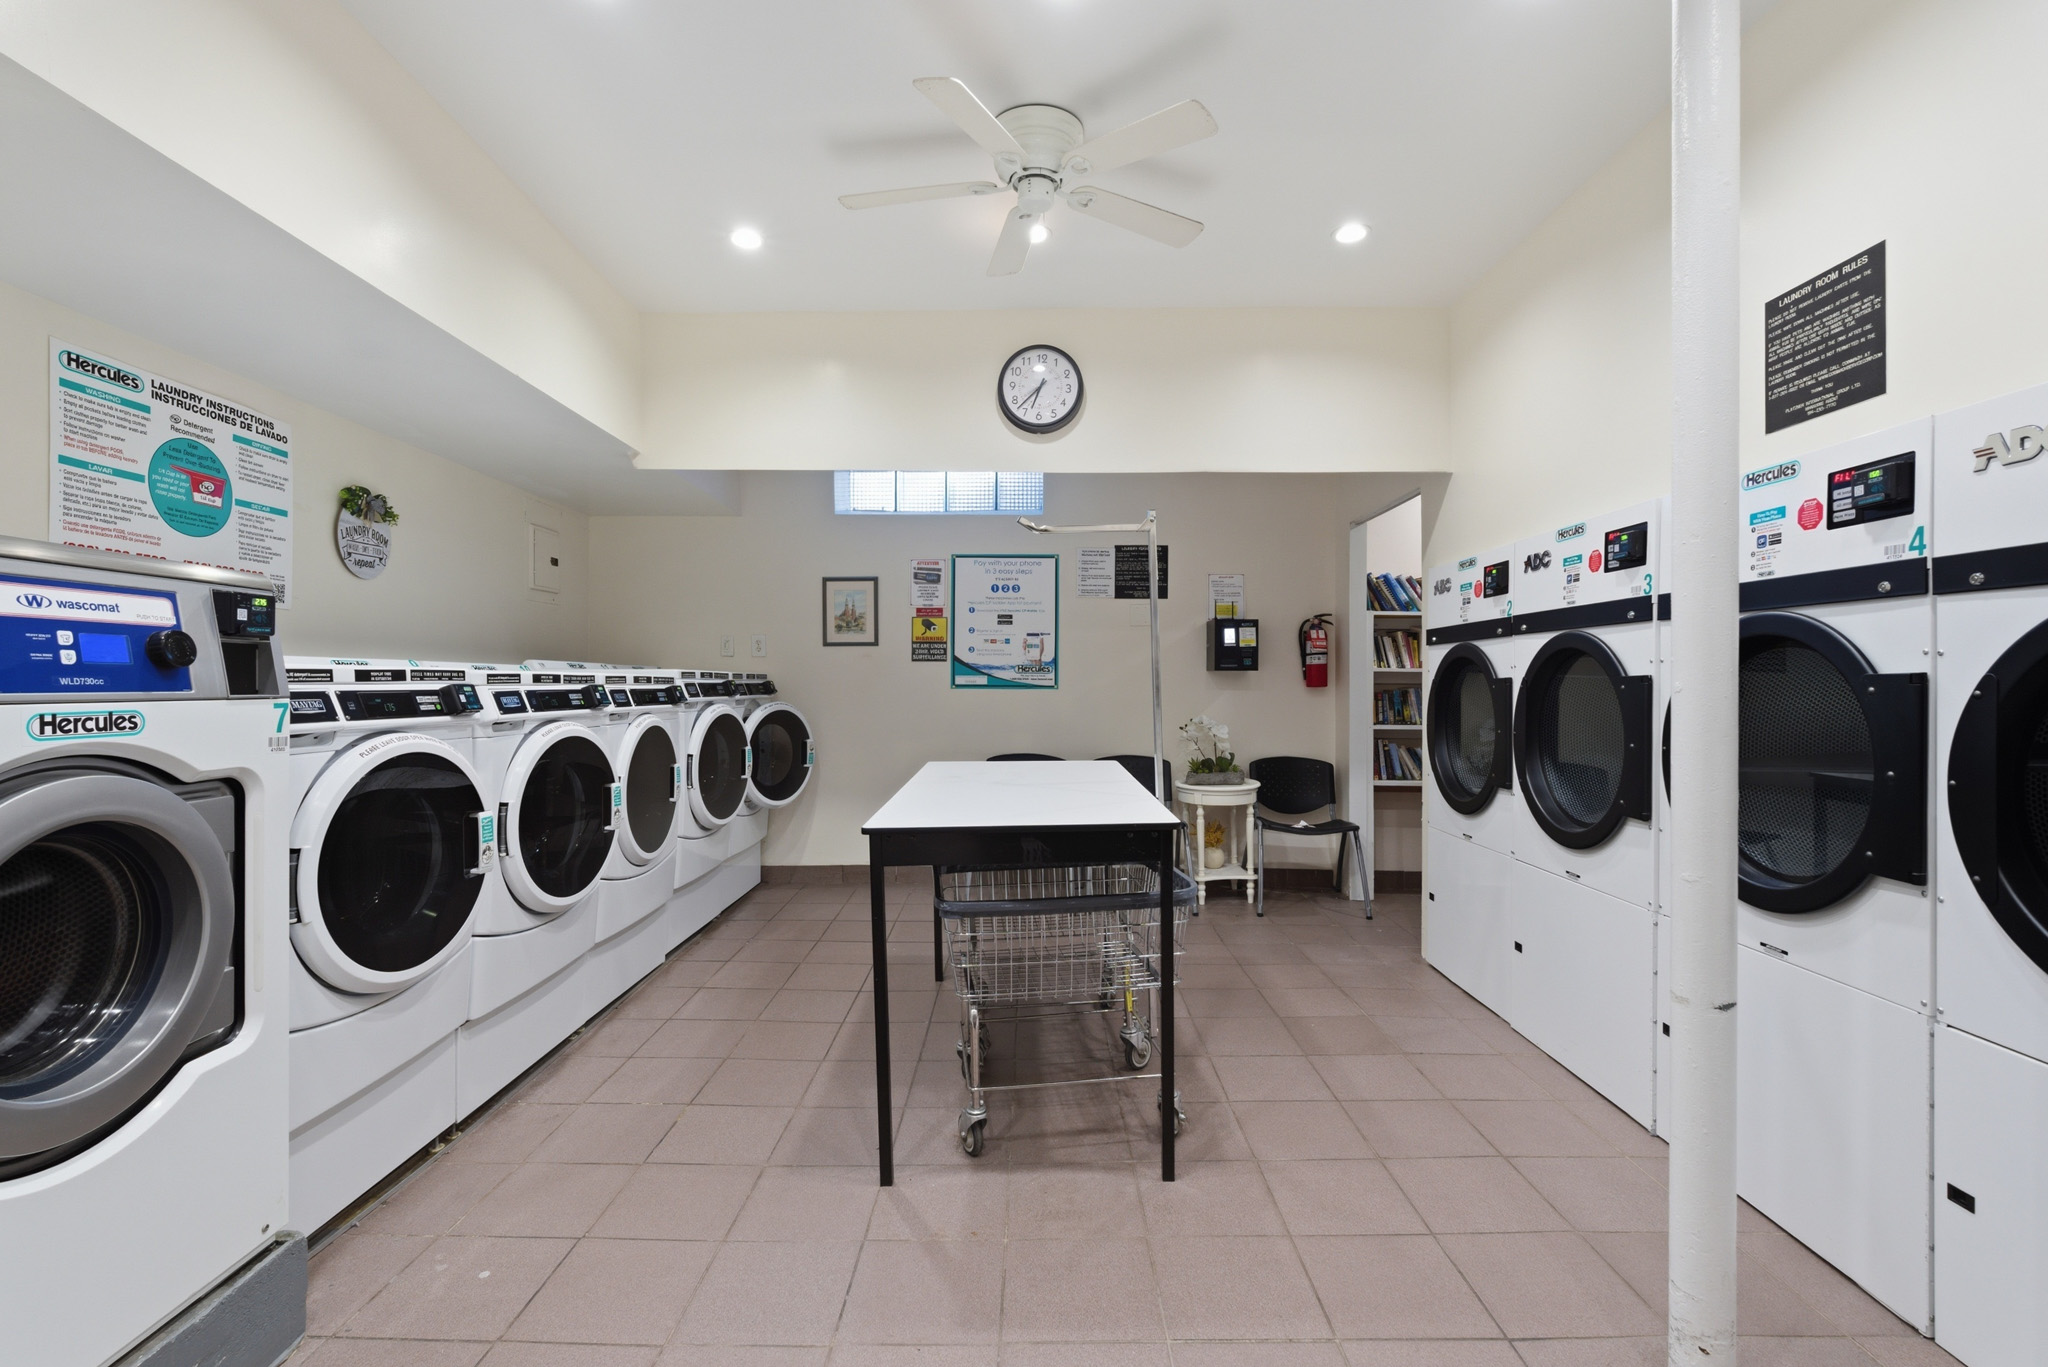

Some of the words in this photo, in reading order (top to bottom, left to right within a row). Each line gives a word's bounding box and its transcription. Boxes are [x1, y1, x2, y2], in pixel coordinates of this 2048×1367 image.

[1779, 284, 1812, 308] LAUNDRY
[1816, 270, 1838, 289] ROOM
[1843, 254, 1868, 275] RULES
[1022, 357, 1031, 366] 11
[1037, 354, 1048, 363] 12
[66, 351, 139, 391] Hercules
[1011, 367, 1021, 376] 10
[1064, 370, 1070, 378] 2
[1010, 382, 1016, 390] 9
[1066, 384, 1071, 393] 3
[86, 387, 121, 404] WASHING
[151, 378, 202, 405] LAUNDRY
[206, 398, 274, 430] INSTRUCTIONS
[1012, 396, 1018, 404] 8
[1060, 398, 1066, 406] 4
[151, 389, 237, 427] INSTRUCCIONES
[240, 420, 252, 432] DE
[256, 426, 287, 444] LAVADO
[1023, 408, 1028, 416] 7
[1036, 411, 1042, 420] 6
[1051, 409, 1057, 418] 5
[171, 424, 215, 444] Recommended
[184, 419, 213, 436] Detergent
[1972, 424, 2048, 473] AD
[89, 464, 112, 475] LAVAR
[1746, 464, 1797, 487] Hercules
[1834, 471, 1855, 483] FIL
[340, 526, 371, 540] LAUNDRY
[372, 529, 388, 548] ROOM
[1558, 525, 1584, 539] Hercules
[1908, 526, 1926, 556] 4
[1524, 550, 1552, 574] ADC
[1644, 574, 1652, 595] 3
[56, 600, 120, 613] wascomat
[1507, 600, 1512, 617] 2
[1017, 665, 1050, 673] Hercules
[38, 712, 138, 735] Hercules
[274, 702, 289, 733] 7
[359, 744, 381, 758] PLEASE
[381, 738, 396, 748] LEAVE
